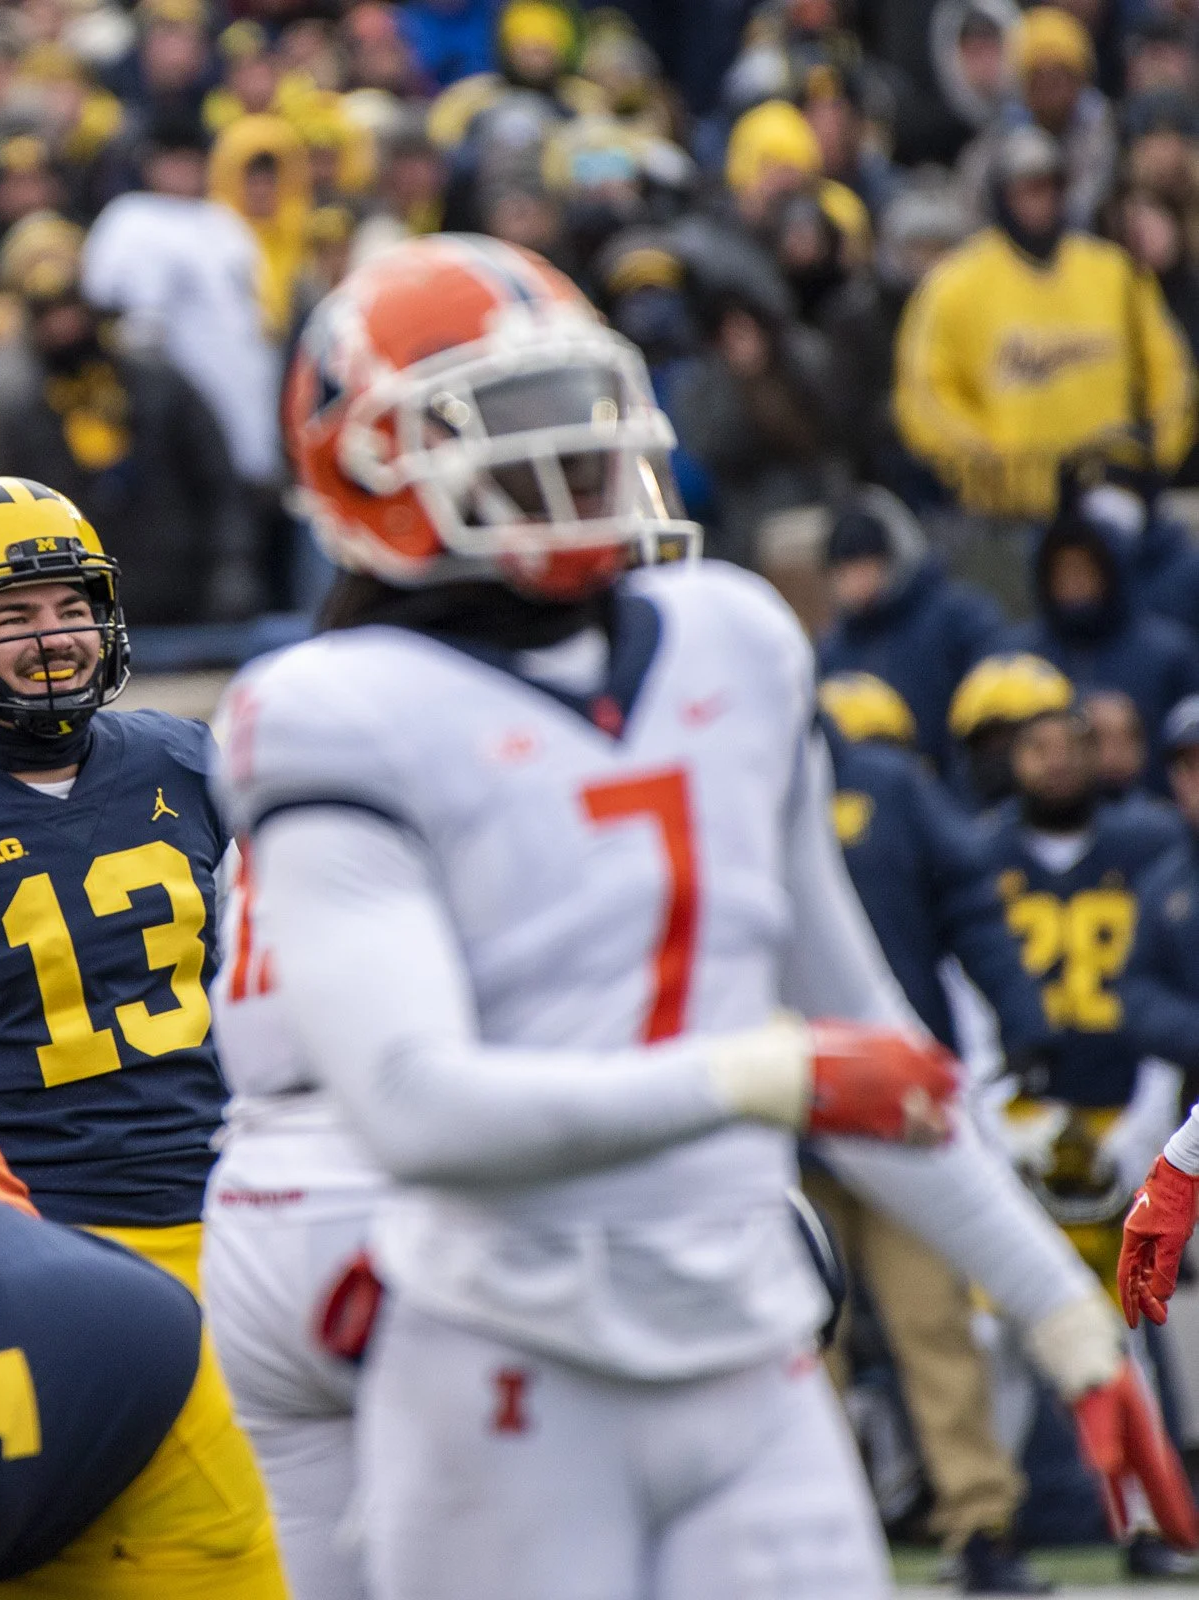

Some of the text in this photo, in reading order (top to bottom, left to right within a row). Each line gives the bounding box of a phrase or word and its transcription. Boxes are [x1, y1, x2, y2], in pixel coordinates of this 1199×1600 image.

[35, 537, 58, 552] M
[2, 841, 212, 1088] 13
[581, 765, 696, 1045] 7
